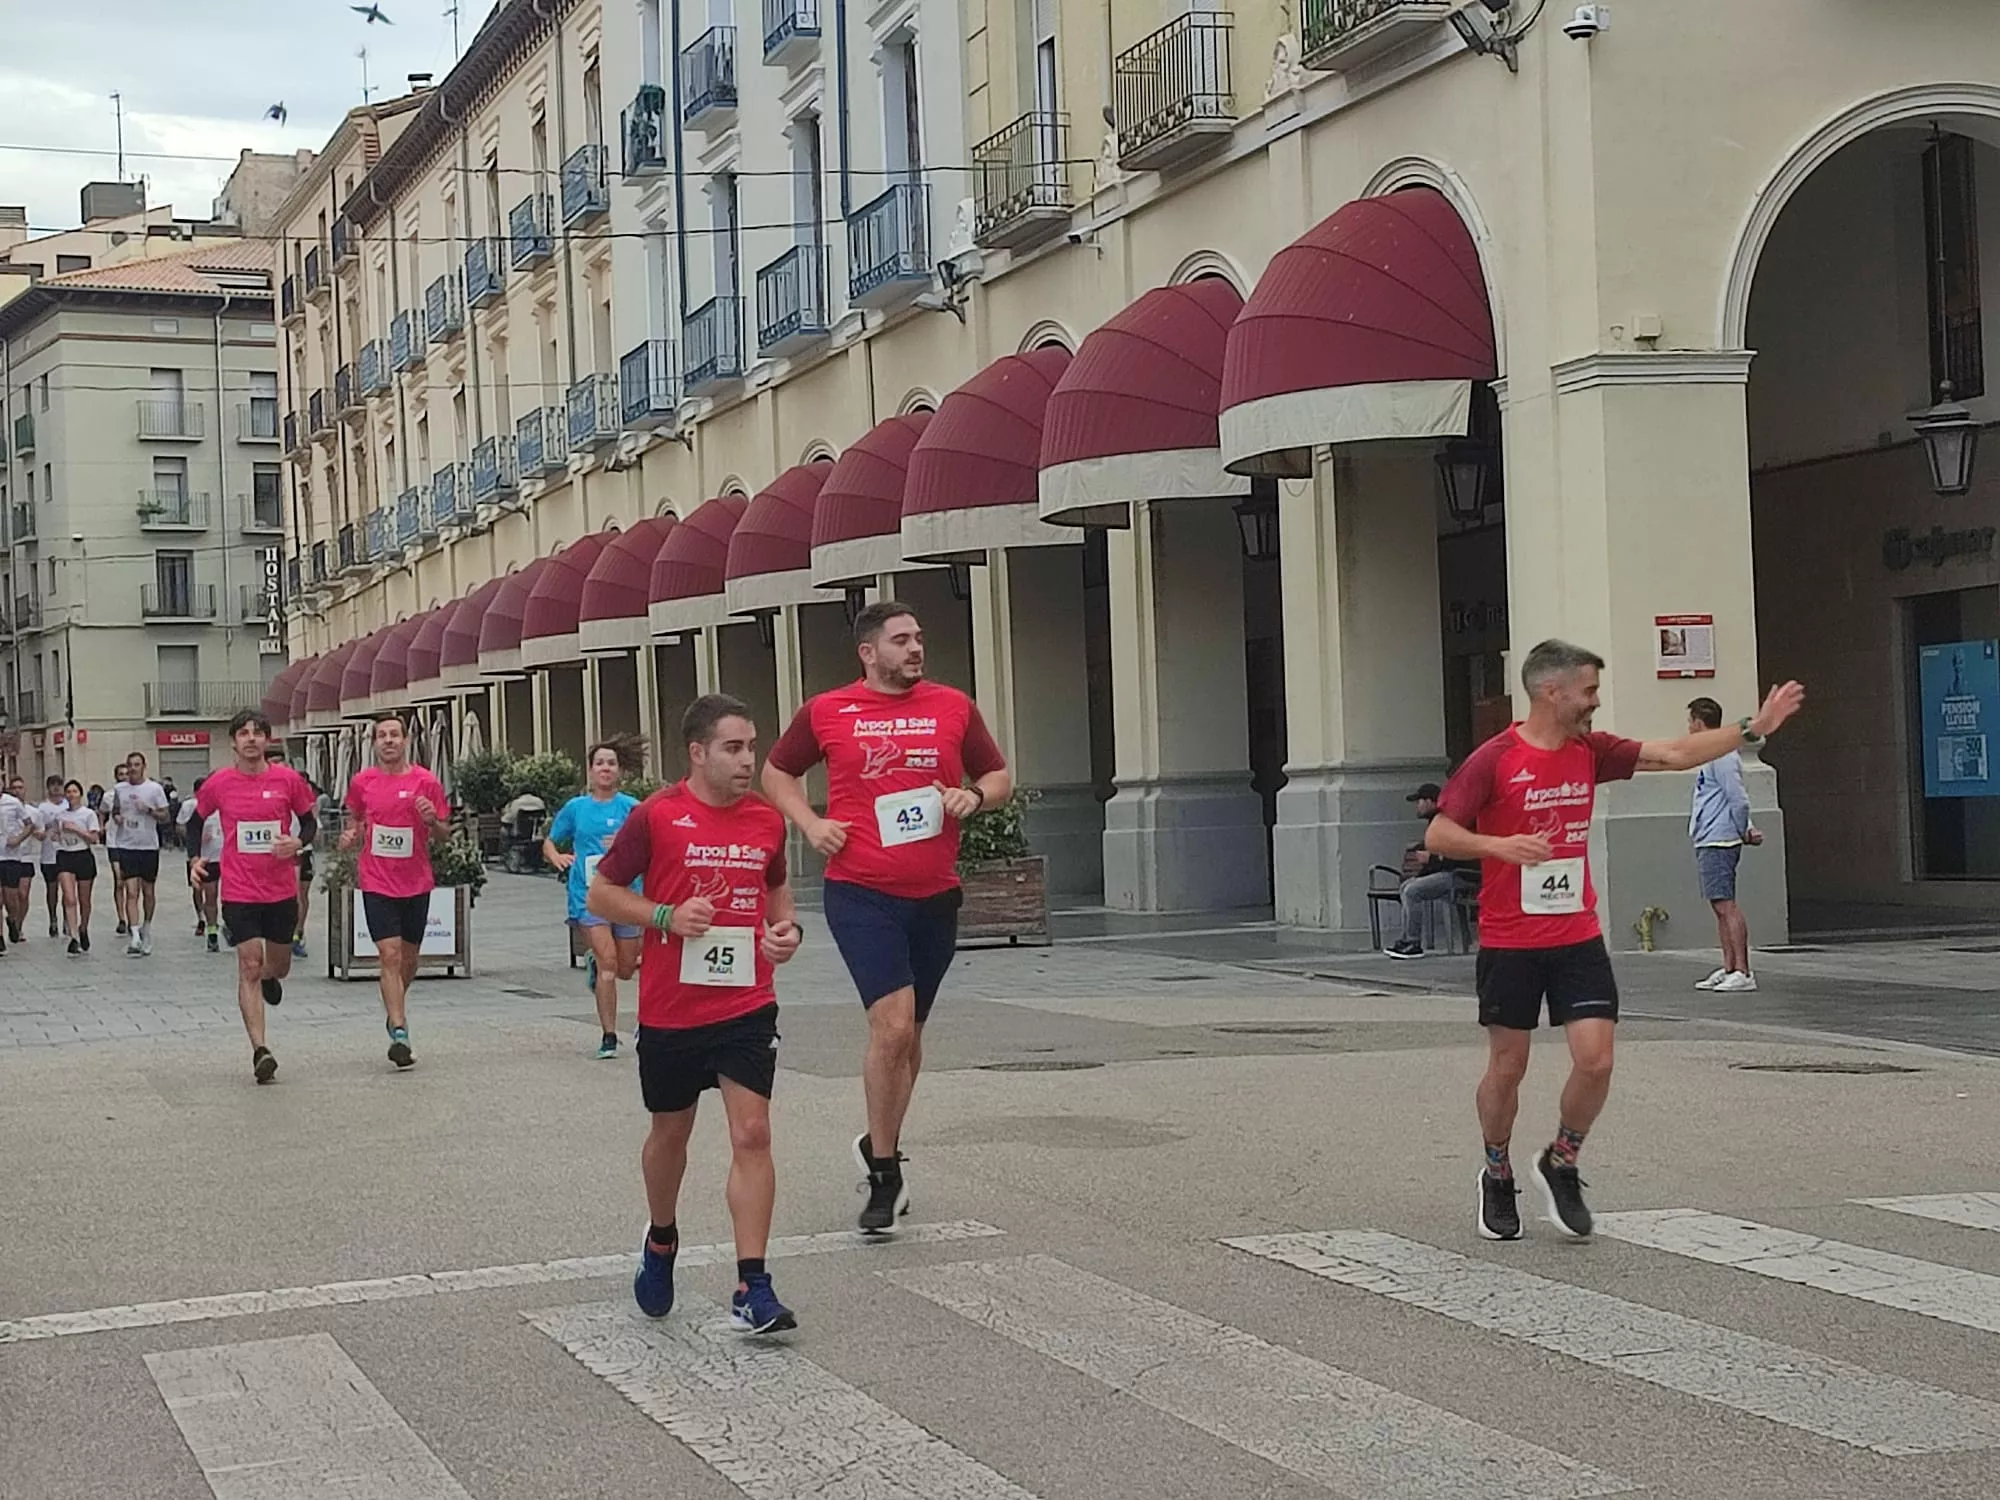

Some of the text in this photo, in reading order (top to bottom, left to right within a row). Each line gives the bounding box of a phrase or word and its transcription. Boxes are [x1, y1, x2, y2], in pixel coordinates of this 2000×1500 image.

[265, 547, 280, 637] HOSTAL
[896, 805, 924, 825] 43
[1542, 873, 1570, 892] 44
[703, 946, 735, 966] 45
